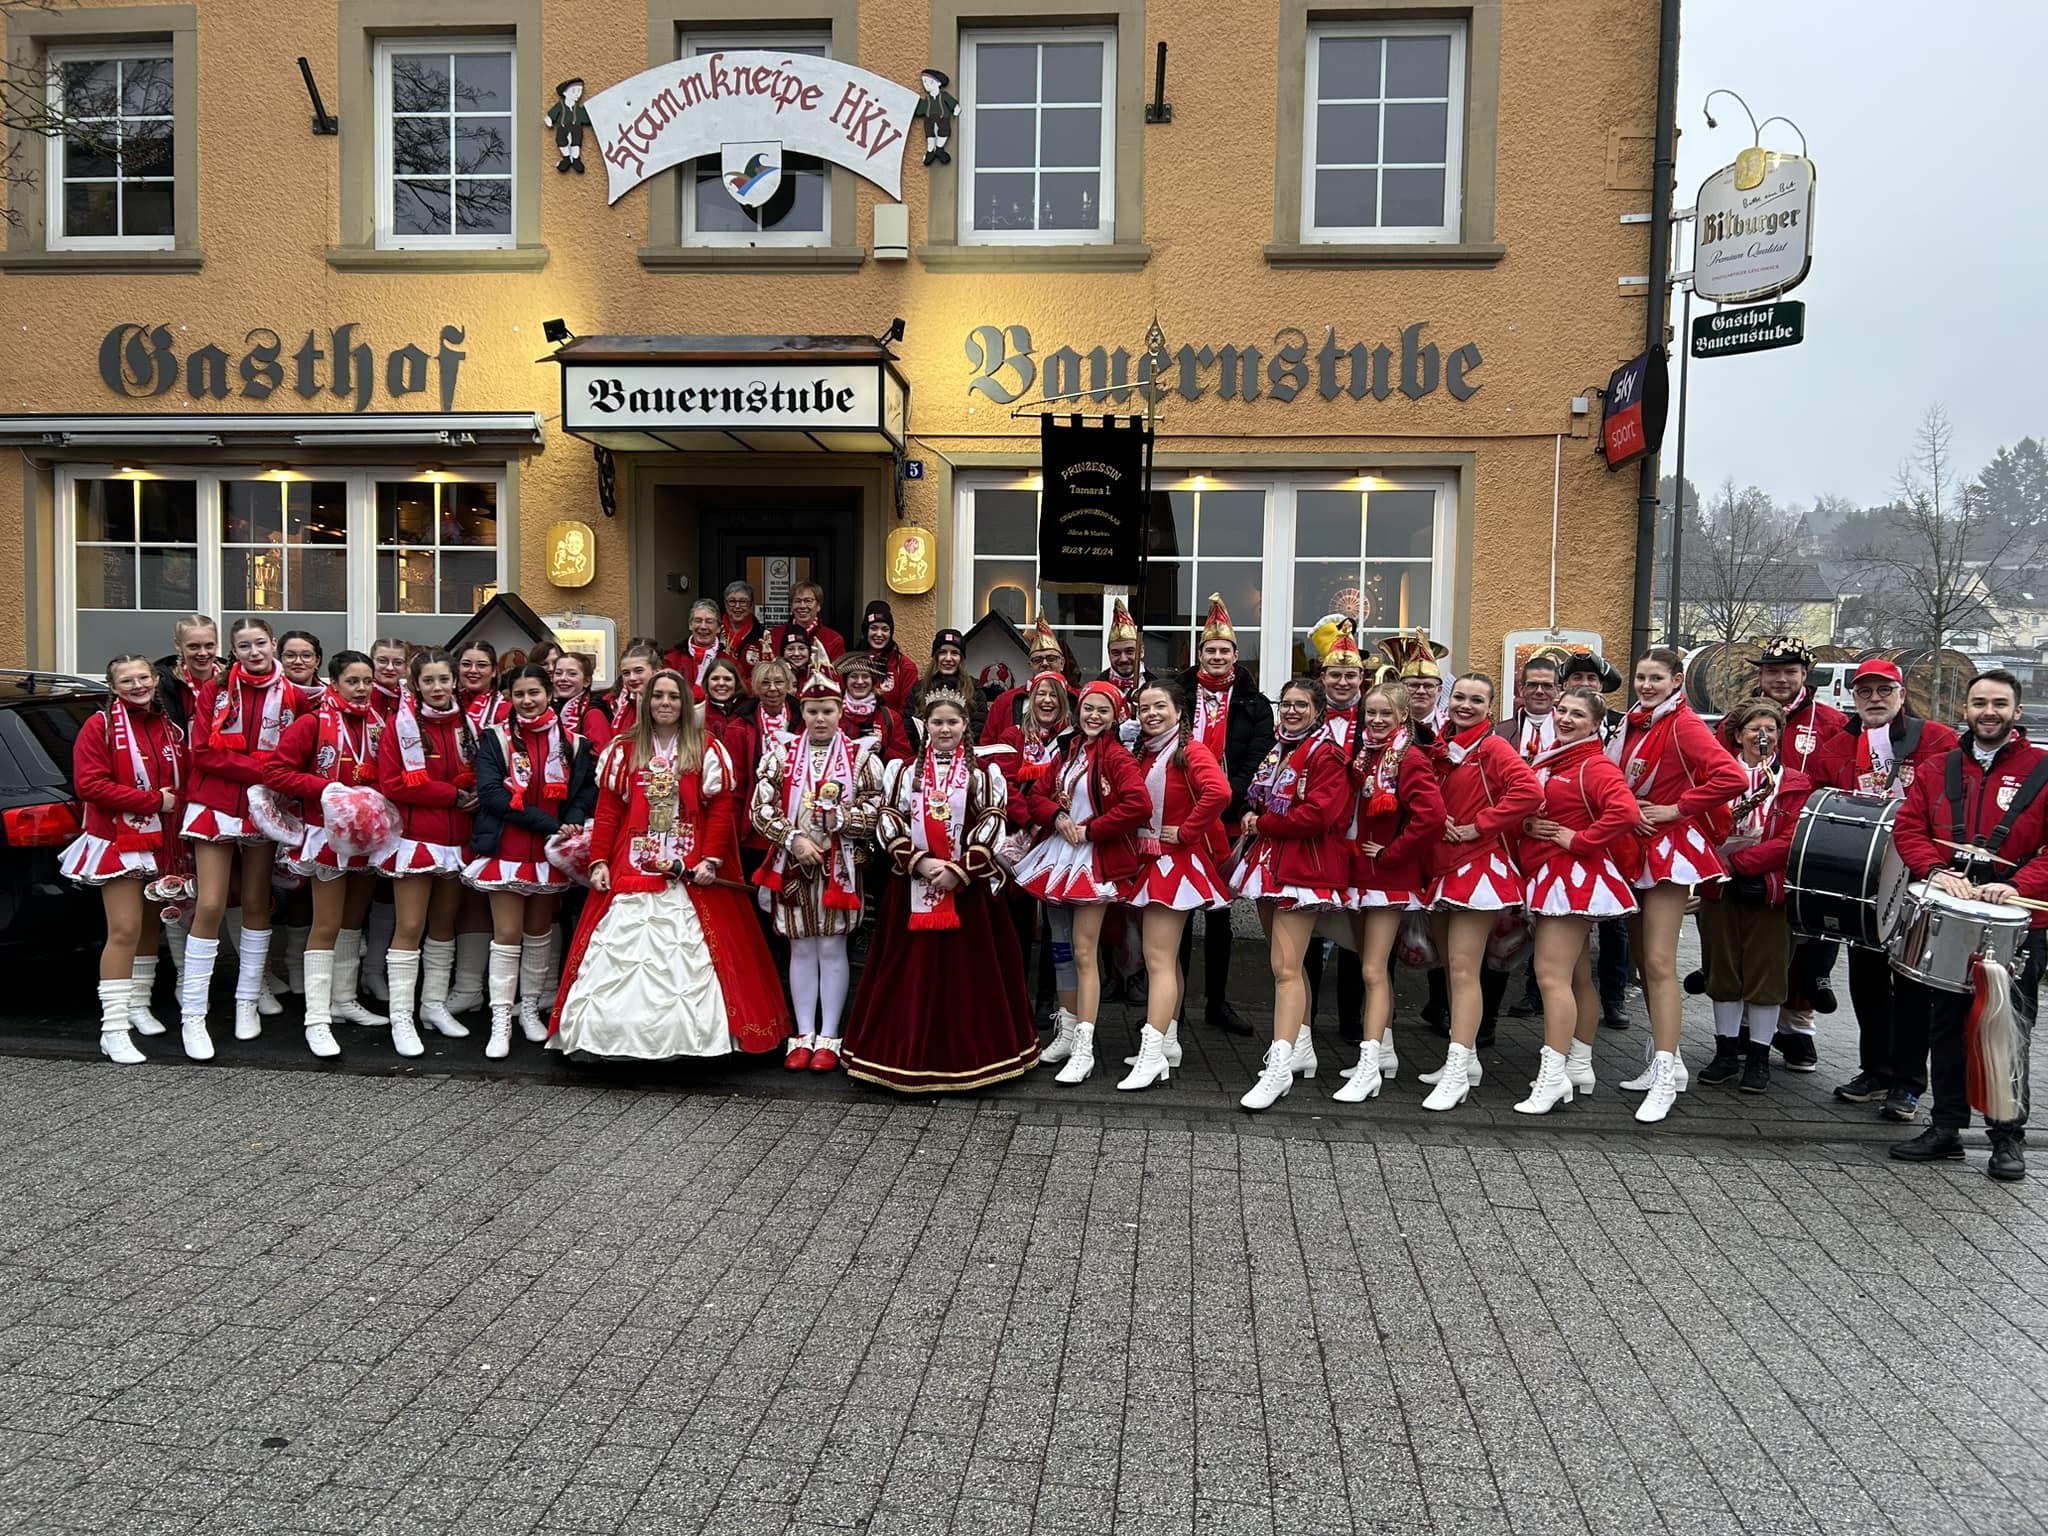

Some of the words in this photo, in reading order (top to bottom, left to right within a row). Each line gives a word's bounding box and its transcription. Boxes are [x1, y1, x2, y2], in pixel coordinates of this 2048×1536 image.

[605, 53, 824, 177] Stammkneipe
[829, 81, 902, 160] HKV
[1701, 207, 1801, 246] Bitburger
[1705, 250, 1744, 268] Premium
[1747, 241, 1788, 259] Qualität
[1711, 307, 1776, 331] Gasthof
[1696, 324, 1794, 352] Bauernstube
[100, 322, 467, 413] Gasthof
[964, 321, 1485, 406] Bauernstube
[588, 378, 856, 414] Bauernstube
[1614, 370, 1637, 403] sky
[1611, 420, 1637, 449] sport
[909, 462, 920, 478] 5
[1061, 462, 1122, 481] PRINZESSIN
[1069, 484, 1103, 495] Tamara
[1061, 545, 1082, 554] 2023
[1092, 547, 1113, 556] 2024
